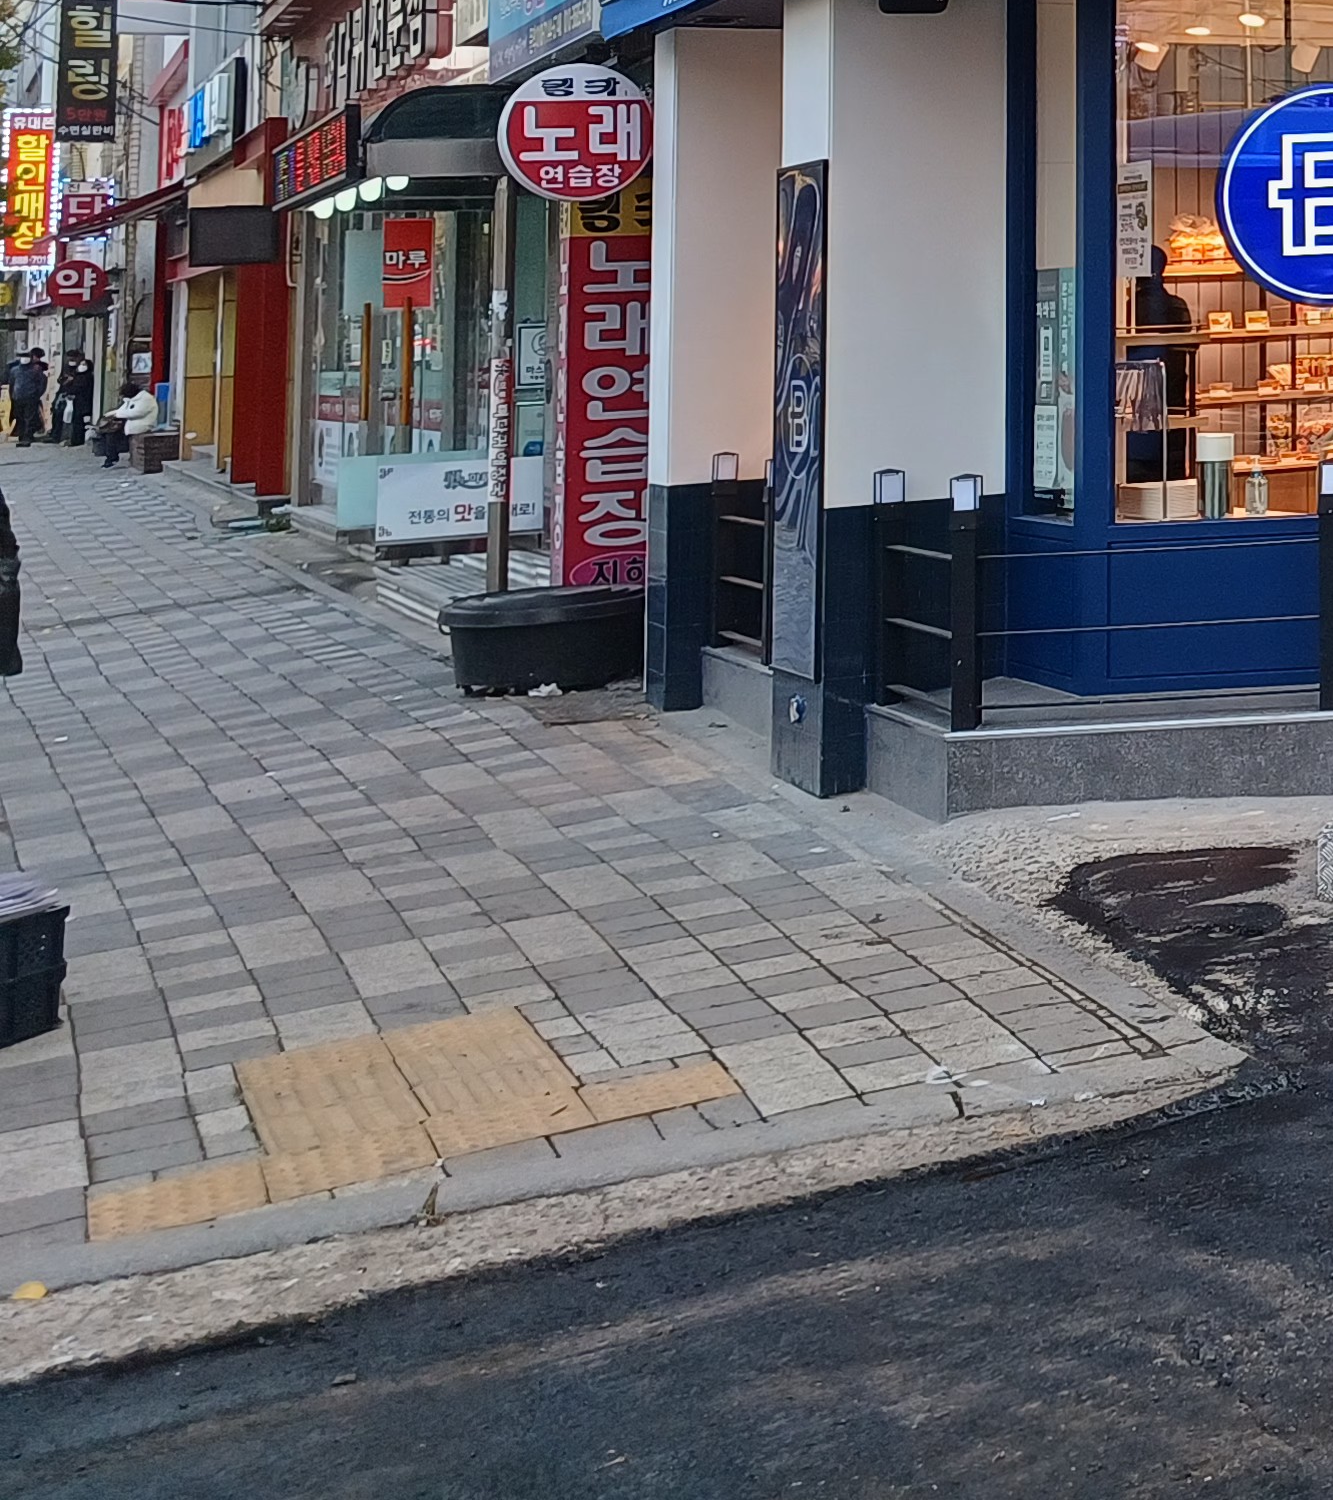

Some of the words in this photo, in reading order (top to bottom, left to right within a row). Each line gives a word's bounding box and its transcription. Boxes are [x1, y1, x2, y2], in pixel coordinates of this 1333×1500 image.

[67, 5, 112, 102] 힐링
[519, 103, 642, 162] 노래
[13, 134, 50, 250] 할인매장
[540, 164, 623, 189] 연습장
[384, 250, 428, 269] 마루
[55, 268, 98, 301] 약
[408, 508, 451, 525] 전통의
[454, 503, 487, 523] 맛을
